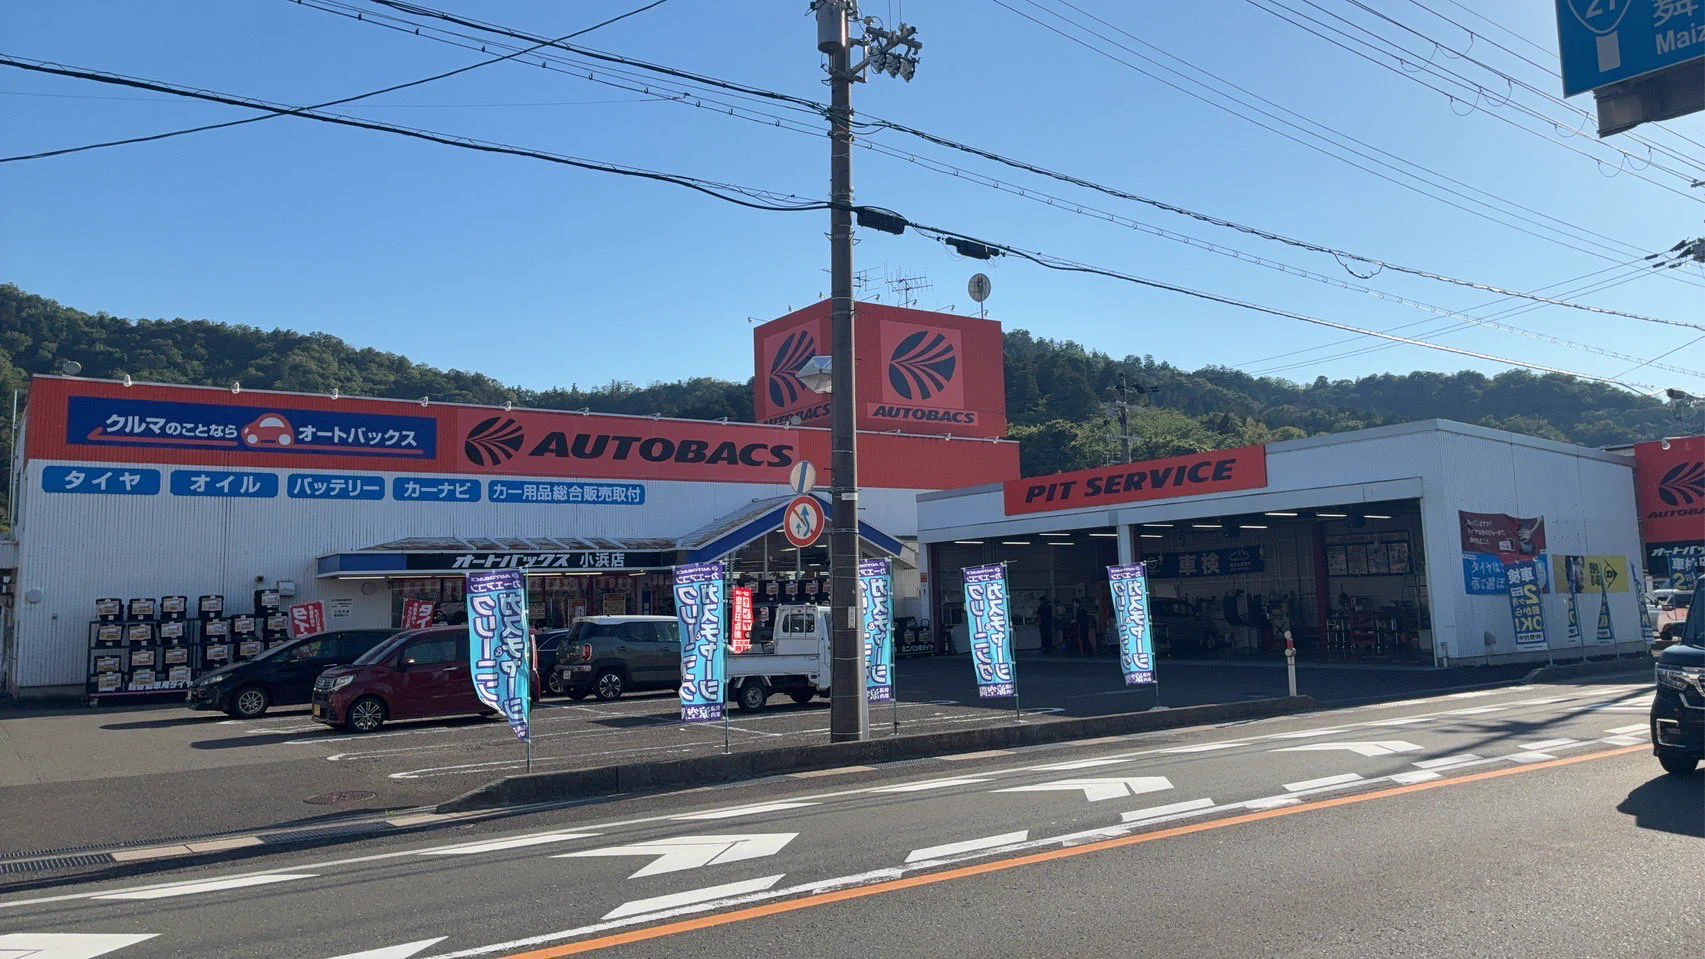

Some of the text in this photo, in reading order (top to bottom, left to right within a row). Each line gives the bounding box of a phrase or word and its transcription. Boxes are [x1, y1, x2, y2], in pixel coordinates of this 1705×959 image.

[872, 405, 976, 424] AUTOBACS
[105, 414, 418, 447] クルマのことなら オートバックス
[528, 431, 794, 468] AUTOBACS
[64, 471, 142, 490] タイヤ
[190, 475, 262, 493] オイル
[294, 478, 380, 497] バッテリー
[1025, 458, 1237, 504] PIT SERVICE
[404, 482, 472, 499] カーナビ
[493, 484, 641, 504] カー用品総合販売取付
[451, 552, 625, 568] オートバックス 小浜店
[1178, 552, 1220, 576] 車検
[742, 596, 753, 631] タイヤ
